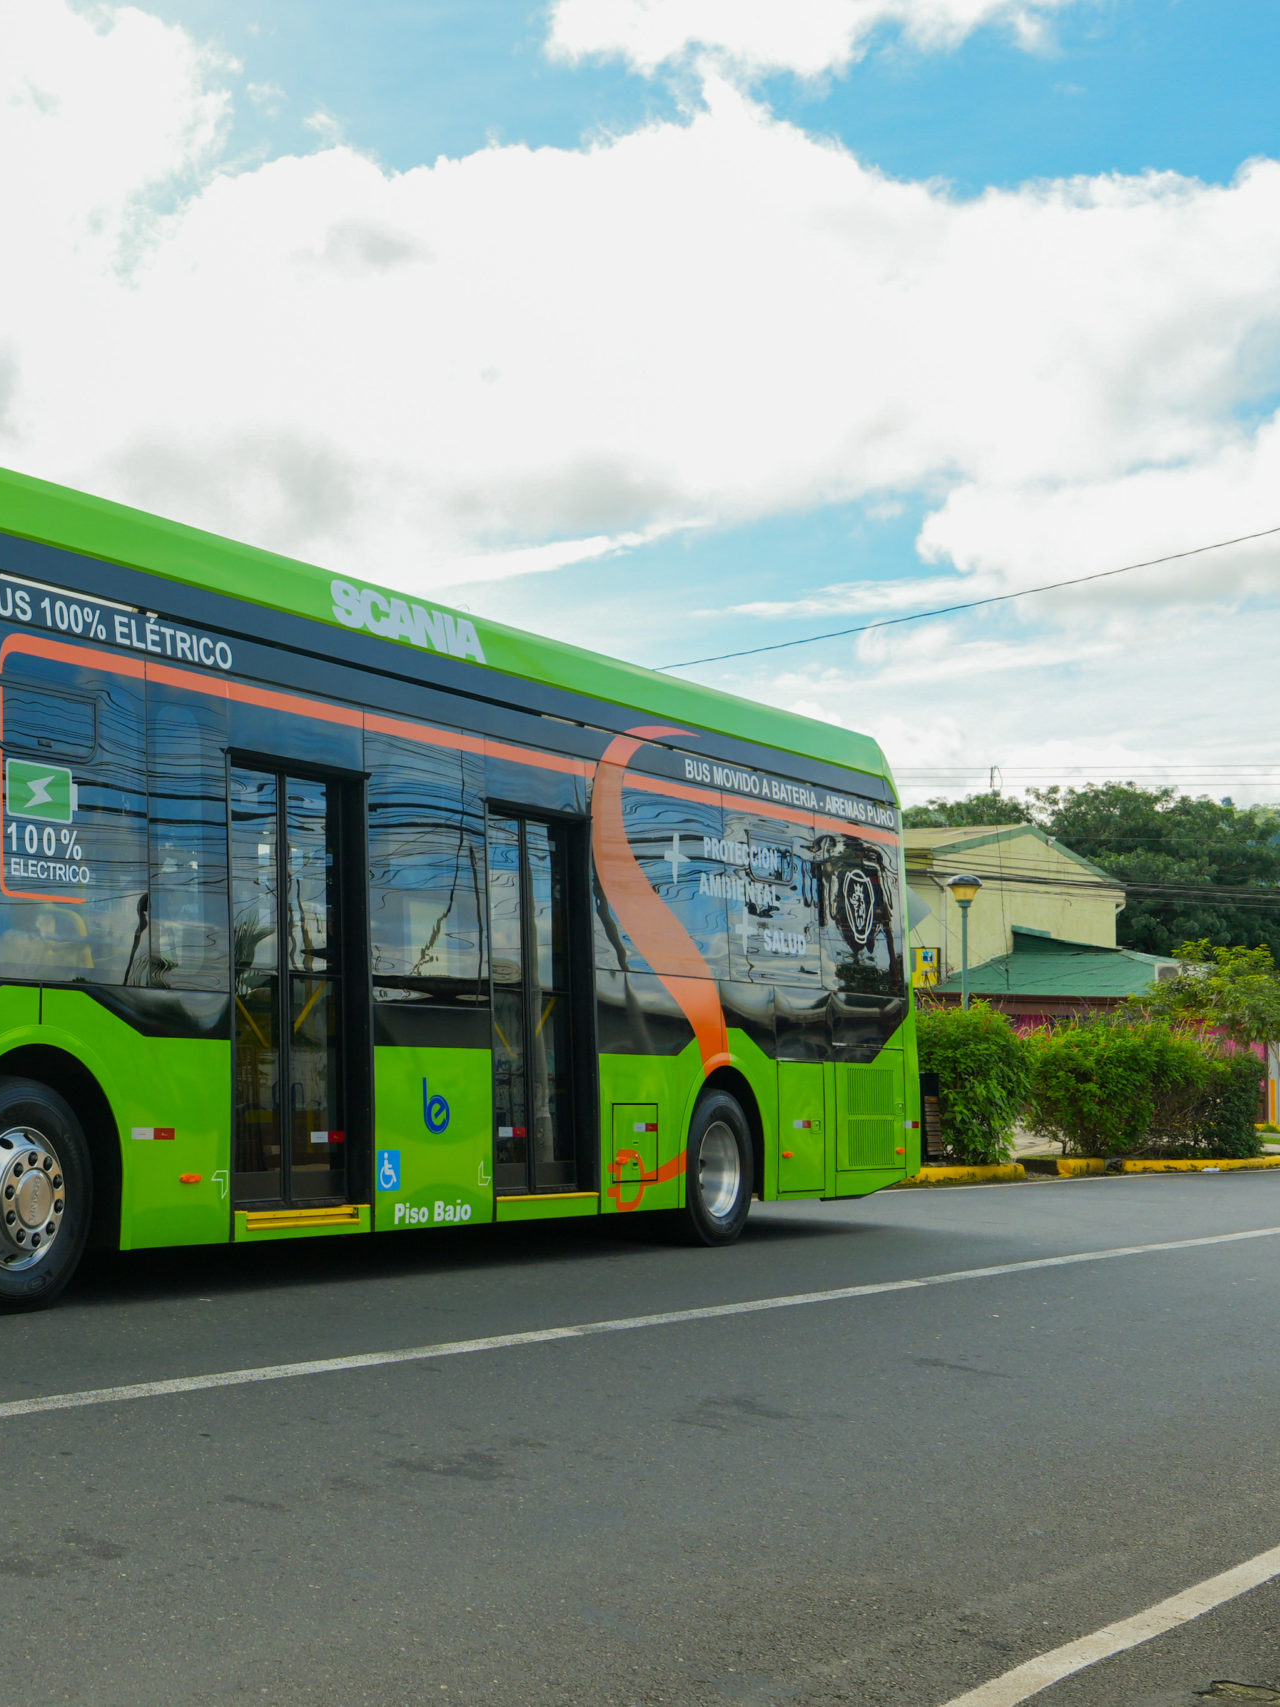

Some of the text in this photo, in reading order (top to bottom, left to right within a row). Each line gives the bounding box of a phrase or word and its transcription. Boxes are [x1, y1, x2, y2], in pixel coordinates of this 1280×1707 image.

[40, 596, 107, 641] 100%
[114, 614, 232, 670] ELÉTRICO
[330, 579, 487, 665] SCANIA
[684, 759, 711, 783] BUS
[713, 765, 760, 795] MOVIDO
[762, 782, 770, 797] A
[772, 781, 818, 810] BATERIA
[867, 807, 895, 828] PURO
[7, 821, 82, 861] 100%
[703, 836, 779, 872] PROTECCION
[10, 857, 90, 883] ELECTRICO
[763, 929, 807, 955] SALUD
[394, 1199, 472, 1225] Piso Bajo
